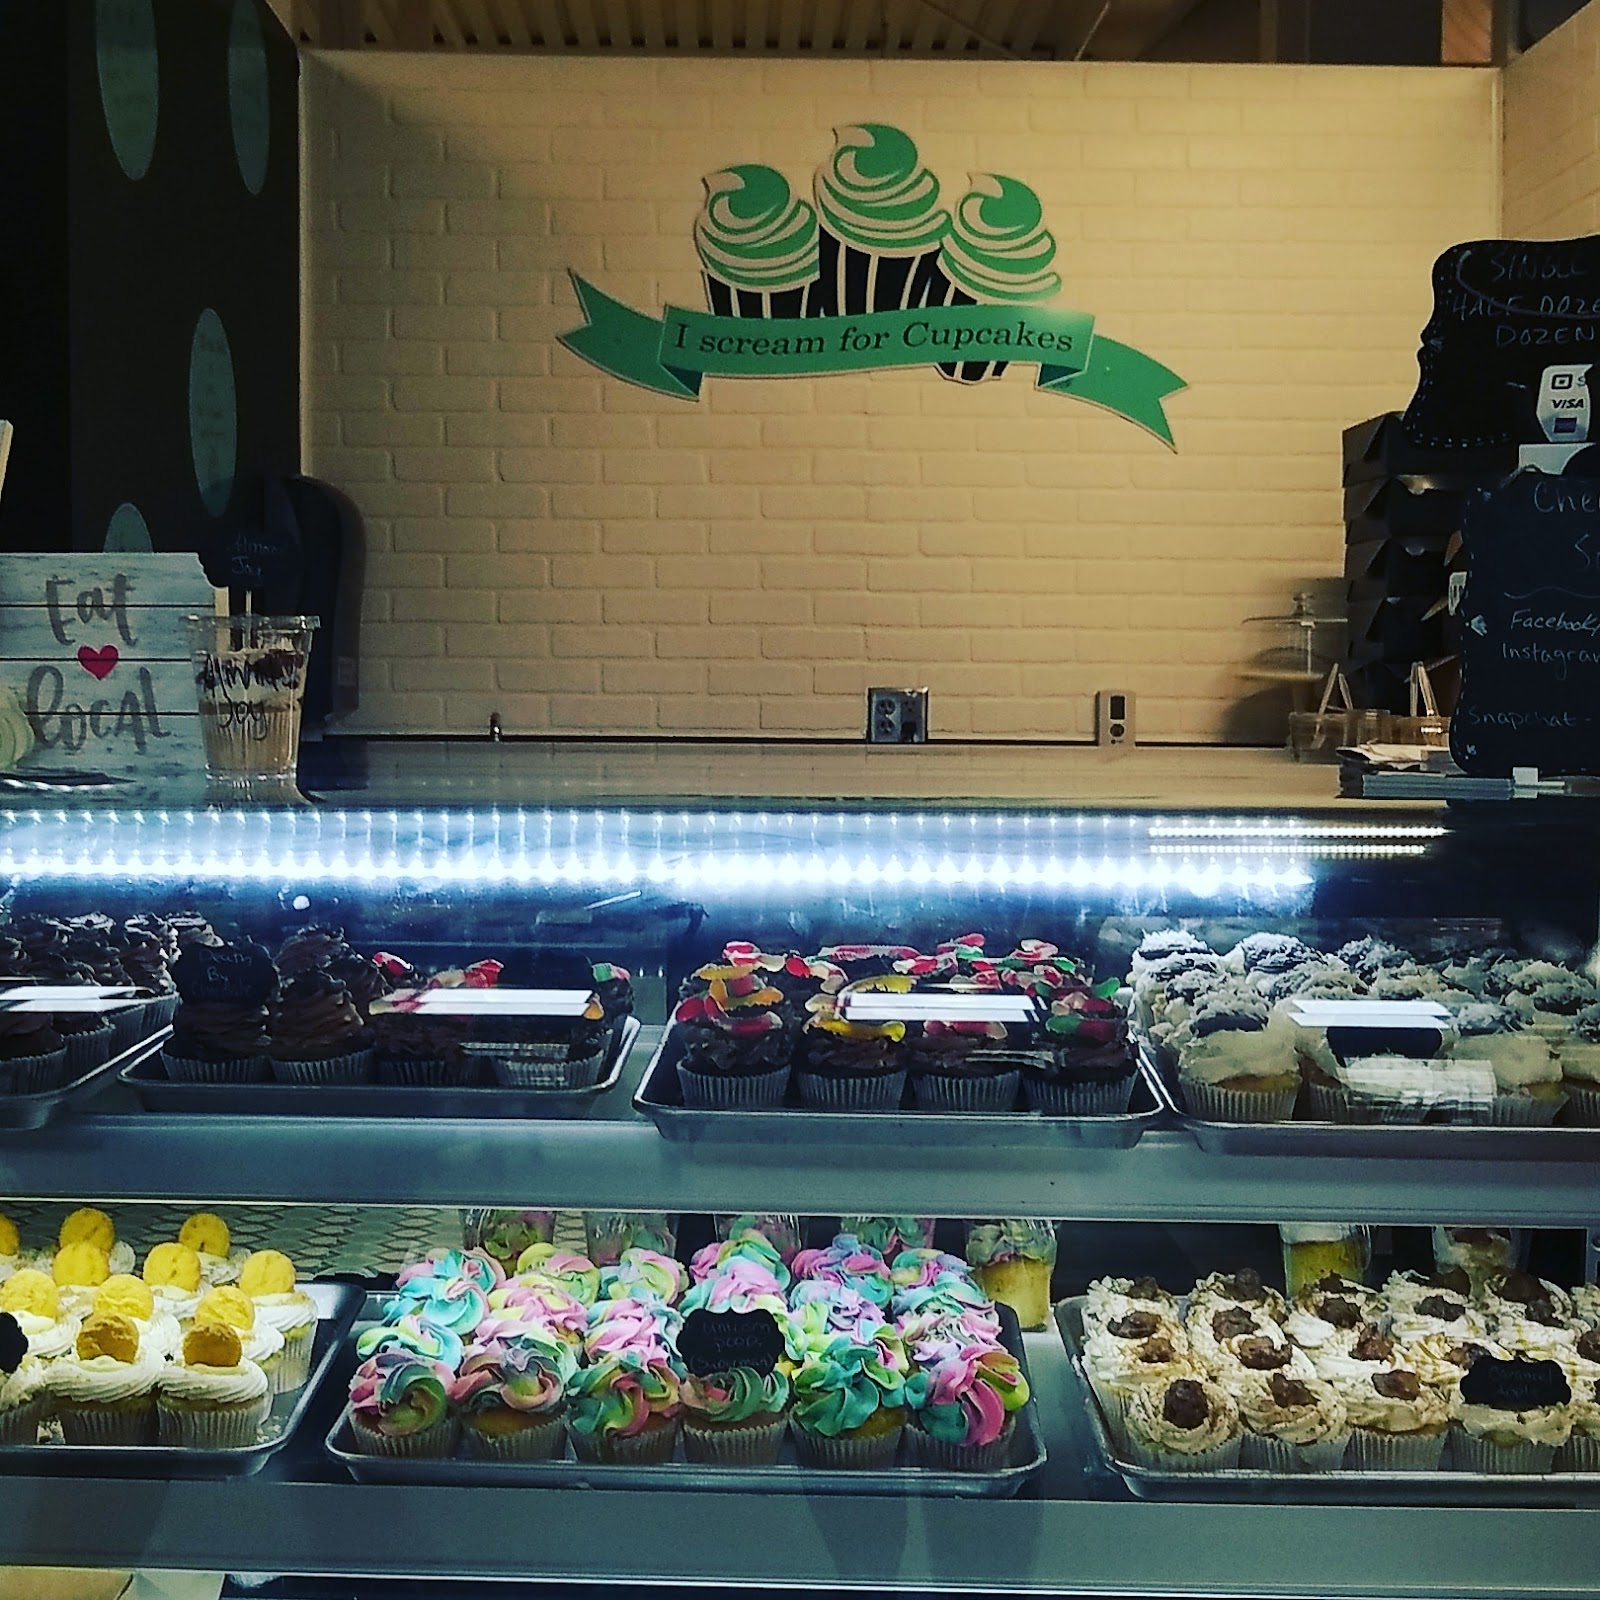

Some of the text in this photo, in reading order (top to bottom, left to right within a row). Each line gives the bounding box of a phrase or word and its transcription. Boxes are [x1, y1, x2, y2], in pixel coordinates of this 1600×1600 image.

[1452, 293, 1524, 321] HALF
[675, 320, 1073, 356] I scream for Cupcakes
[1496, 325, 1595, 347] DOZEN
[1552, 399, 1584, 409] VISA
[46, 573, 138, 646] Eat
